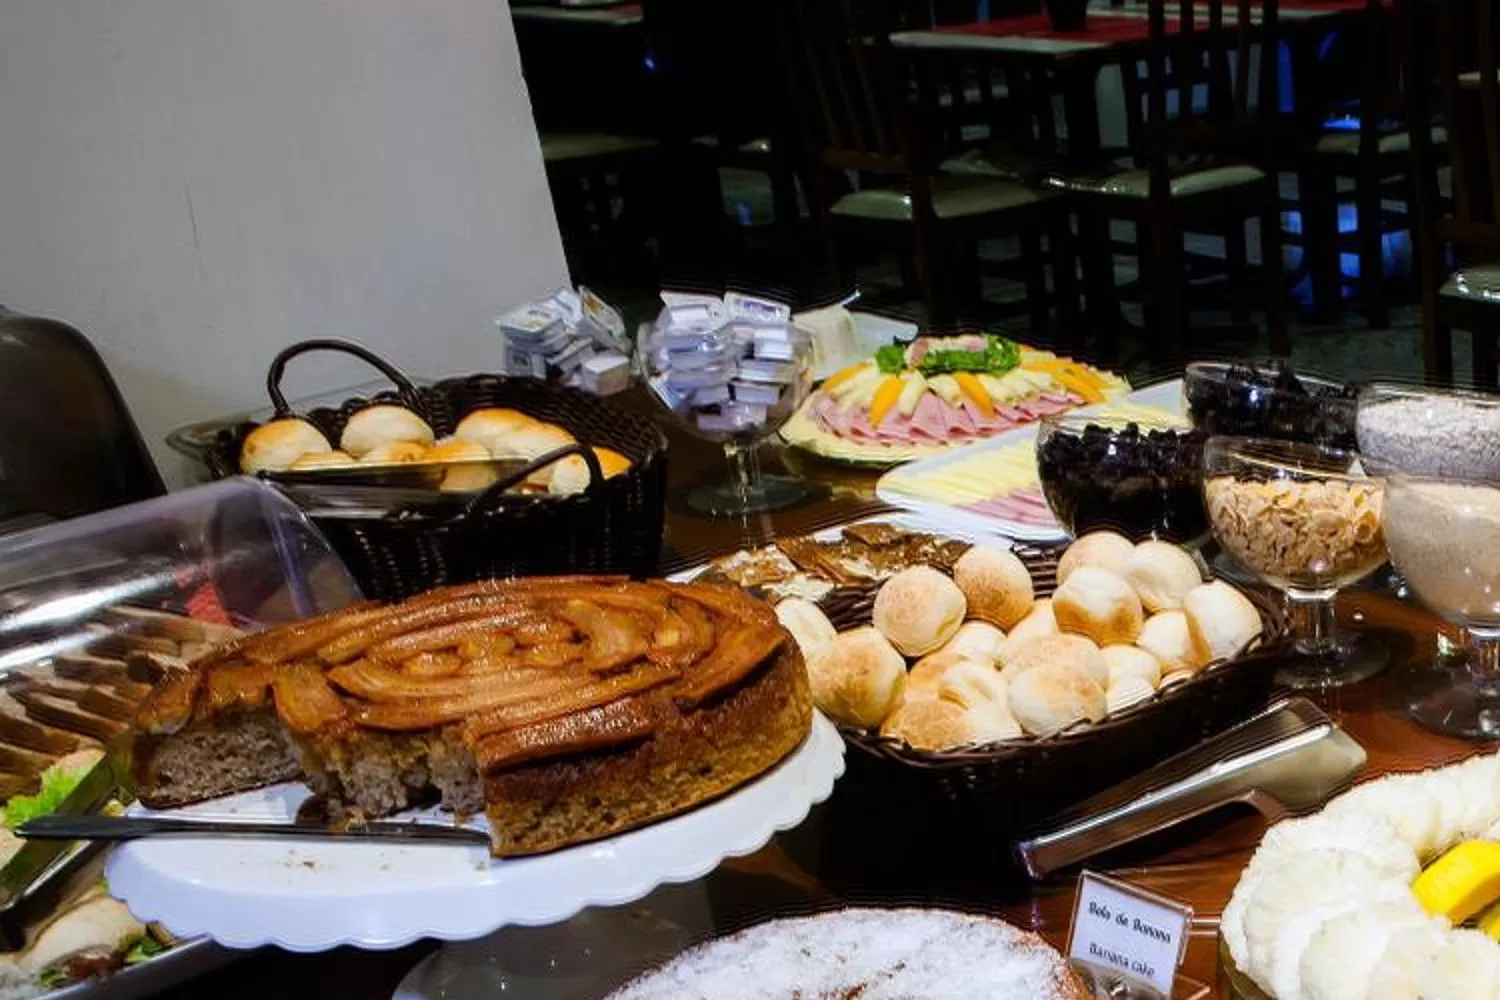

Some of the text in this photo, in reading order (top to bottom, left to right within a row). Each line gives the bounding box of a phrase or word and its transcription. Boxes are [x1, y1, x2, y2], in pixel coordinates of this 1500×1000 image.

[1088, 900, 1172, 945] Bolo de Banana
[1089, 941, 1156, 977] Banana cake
